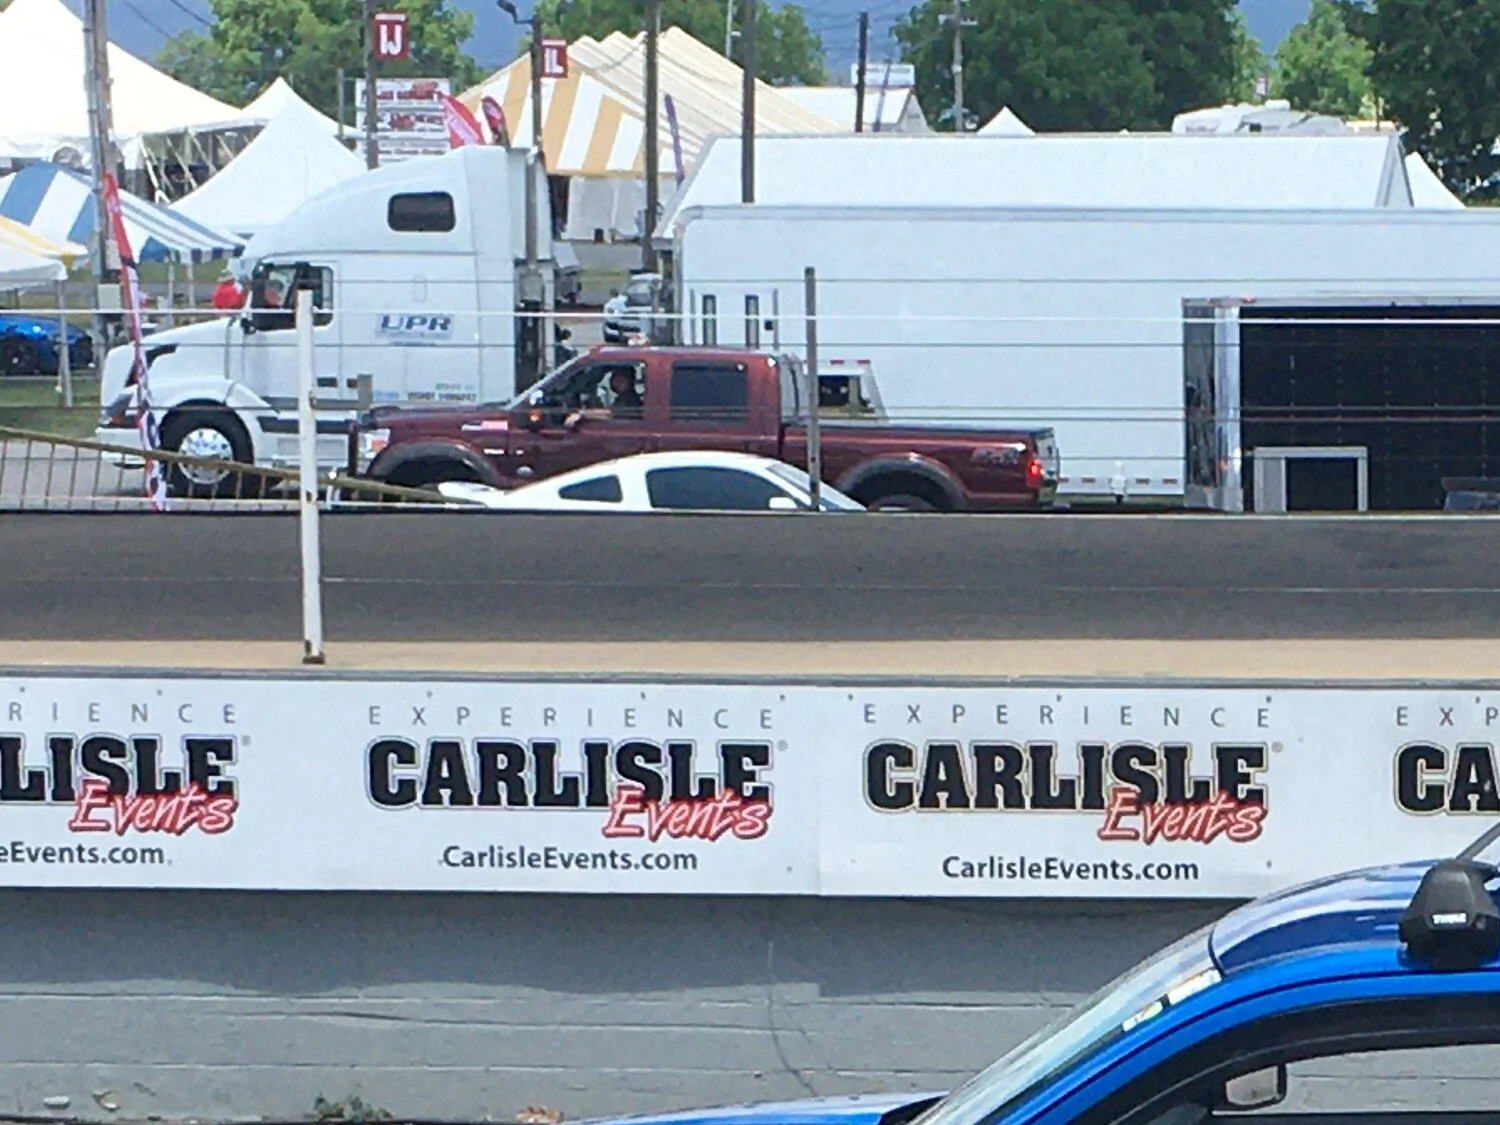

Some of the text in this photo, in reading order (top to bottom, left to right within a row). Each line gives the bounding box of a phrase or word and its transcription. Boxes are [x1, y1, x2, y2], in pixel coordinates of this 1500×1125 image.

[380, 315, 452, 331] UPR
[8, 701, 236, 726] RIENCE
[368, 705, 773, 731] EXPERIENCE
[863, 703, 1272, 729] EXPERIENCE
[368, 739, 772, 808] CARLISLE
[866, 742, 1268, 811] CARLISLE
[69, 780, 238, 834] Events
[602, 786, 771, 841] Events
[1100, 788, 1267, 843] Events
[442, 845, 698, 872] CarlisleEvents.com
[942, 855, 1200, 882] CarlisleEvents.com
